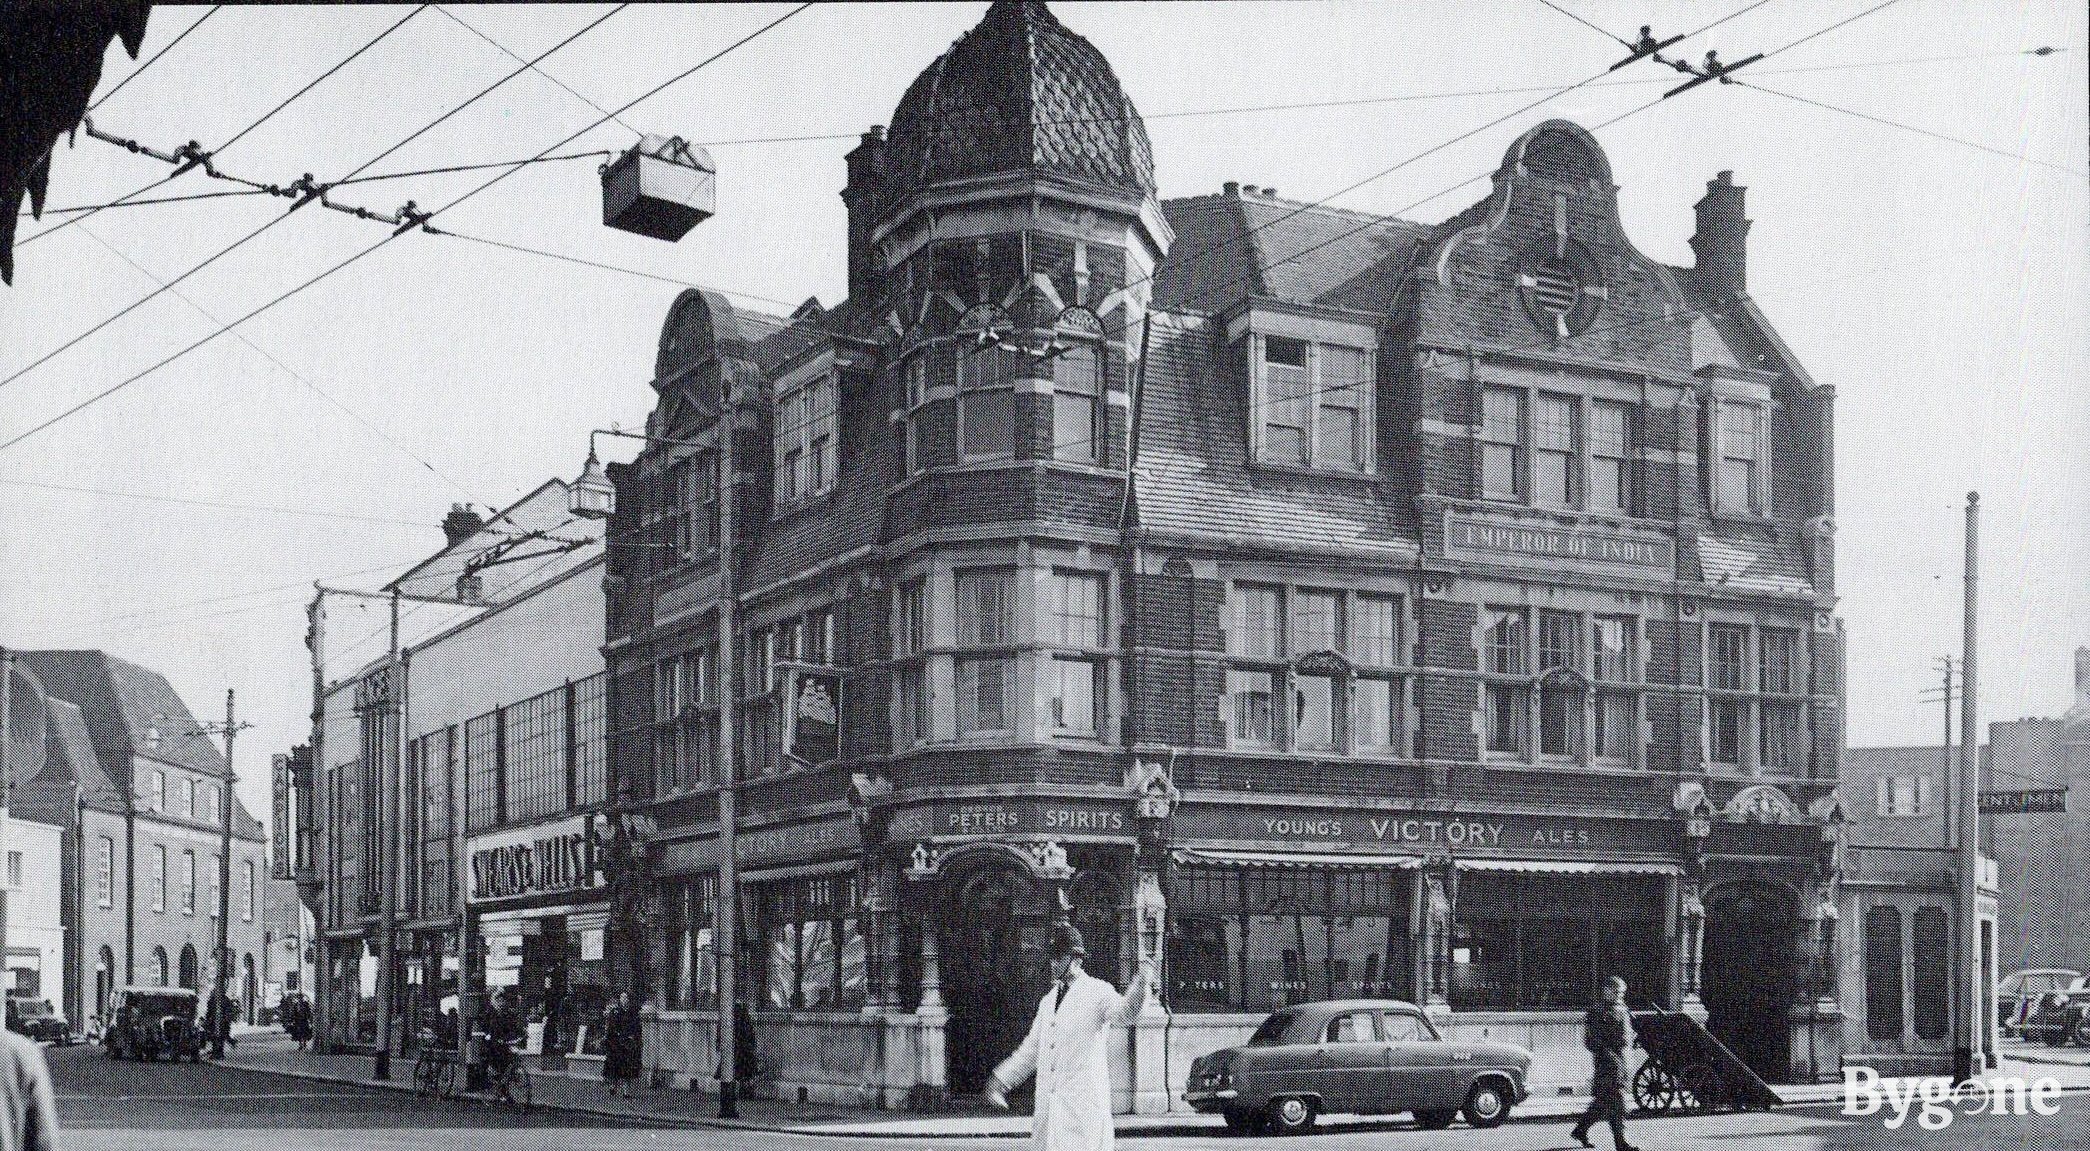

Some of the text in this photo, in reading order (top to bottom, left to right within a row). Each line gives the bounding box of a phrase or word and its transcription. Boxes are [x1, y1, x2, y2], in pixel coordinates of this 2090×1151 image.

[1467, 526, 1656, 563] EMPEROR OF INDIA
[949, 812, 1018, 827] PETERS
[1046, 809, 1123, 829] SPIRITS
[735, 832, 786, 857] CTORY
[803, 828, 835, 844] ALES
[1370, 818, 1505, 845] VICTORY
[1533, 828, 1589, 844] ALES
[1179, 981, 1224, 990] PTERS
